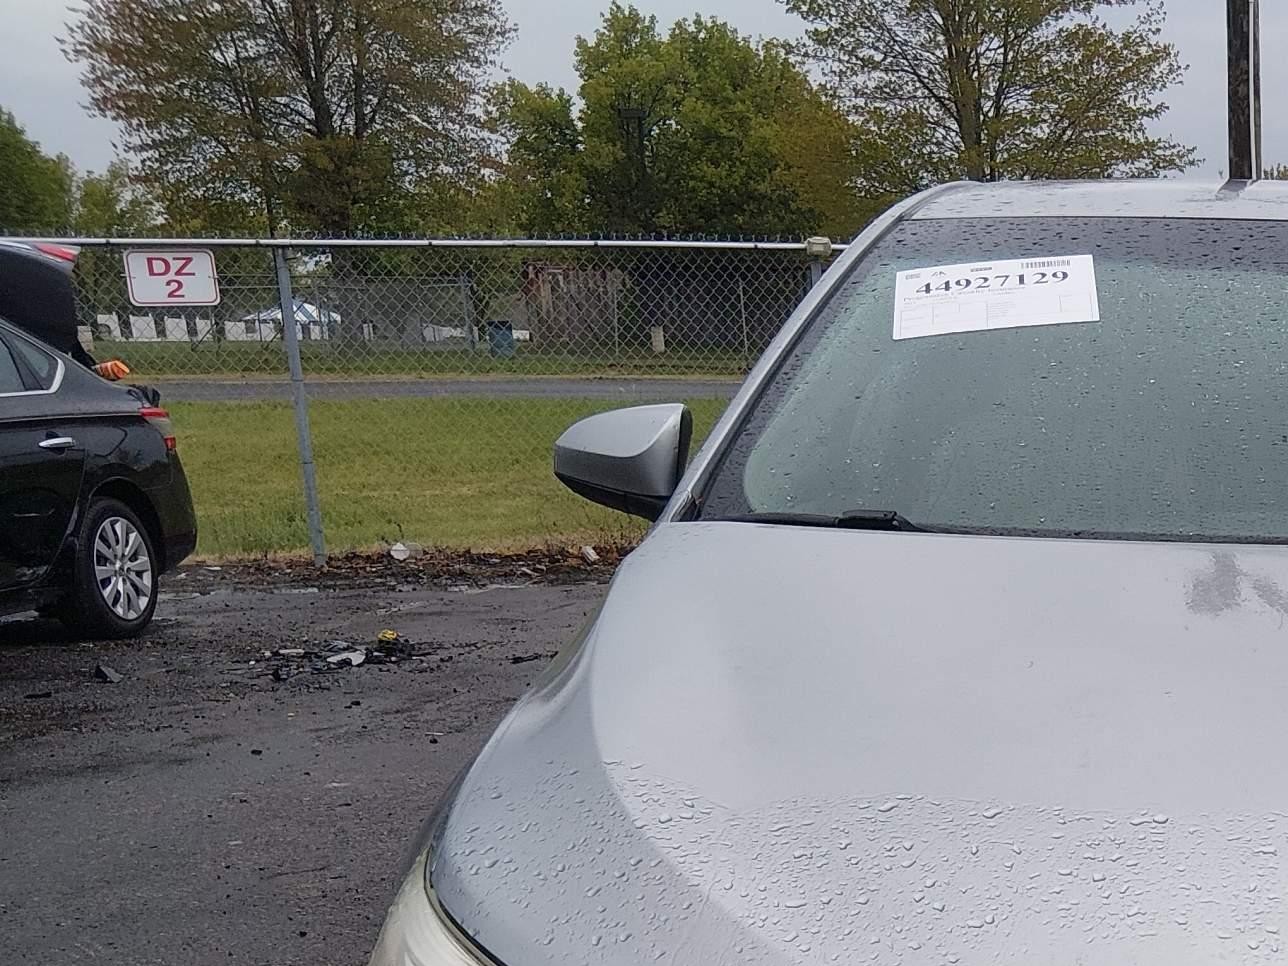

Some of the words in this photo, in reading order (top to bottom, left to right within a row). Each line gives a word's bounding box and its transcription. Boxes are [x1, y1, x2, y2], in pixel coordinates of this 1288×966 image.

[146, 257, 196, 276] DZ
[165, 279, 185, 298] 2
[916, 270, 1069, 295] 44927129
